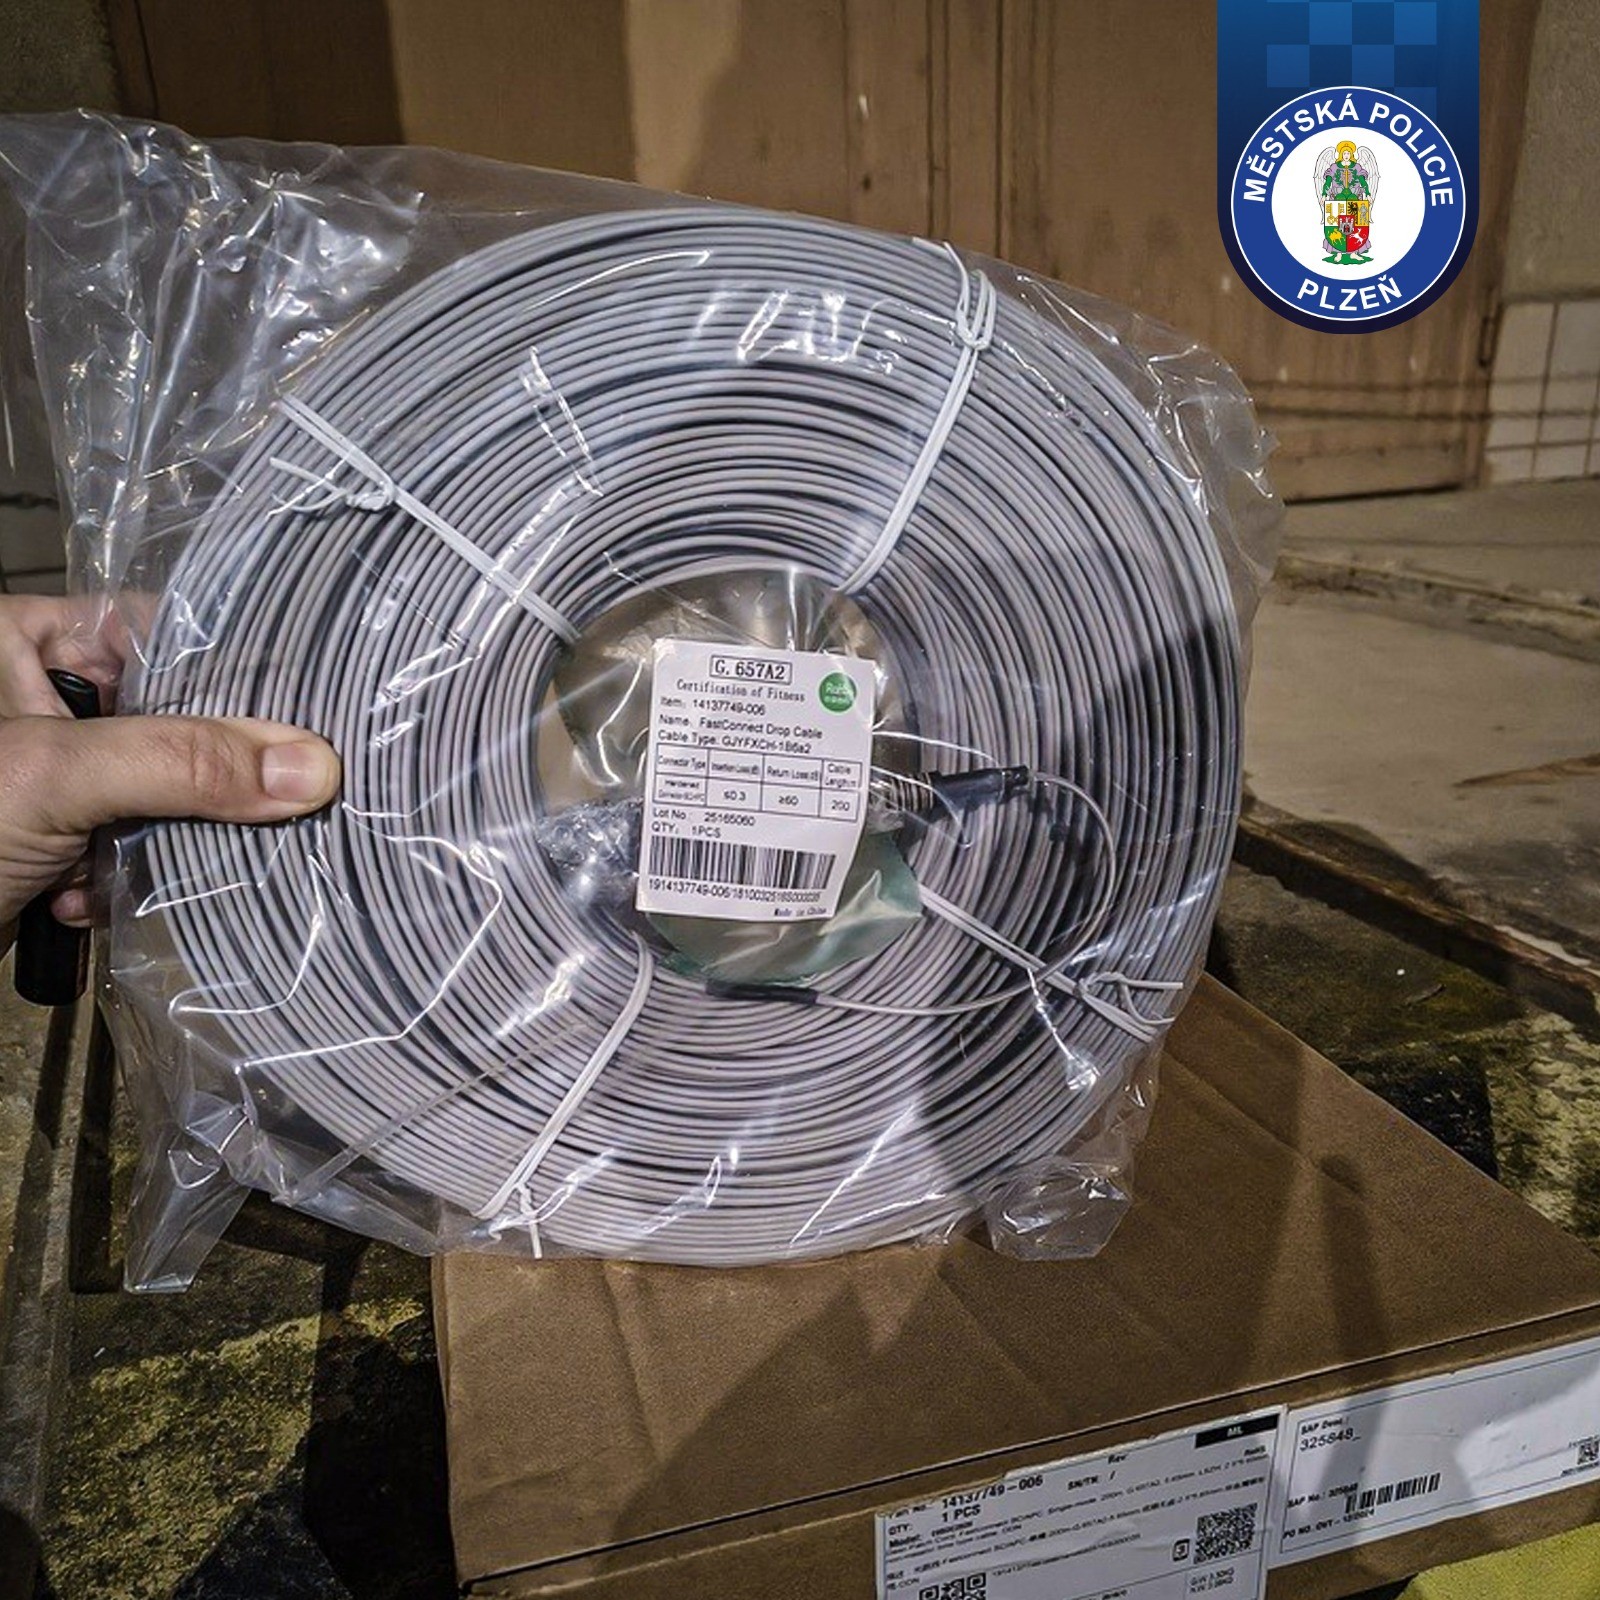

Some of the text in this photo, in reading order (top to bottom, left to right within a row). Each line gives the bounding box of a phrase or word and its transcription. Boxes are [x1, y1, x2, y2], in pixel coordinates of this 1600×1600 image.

[676, 679, 806, 702] Certification of Fitness
[693, 700, 766, 716] 14137749-006
[658, 729, 689, 742] Cable
[699, 717, 764, 734] FastConnect
[766, 723, 791, 737] Drop
[793, 726, 823, 739] Cable
[652, 807, 669, 818] Lot
[953, 1504, 982, 1521] PCS
